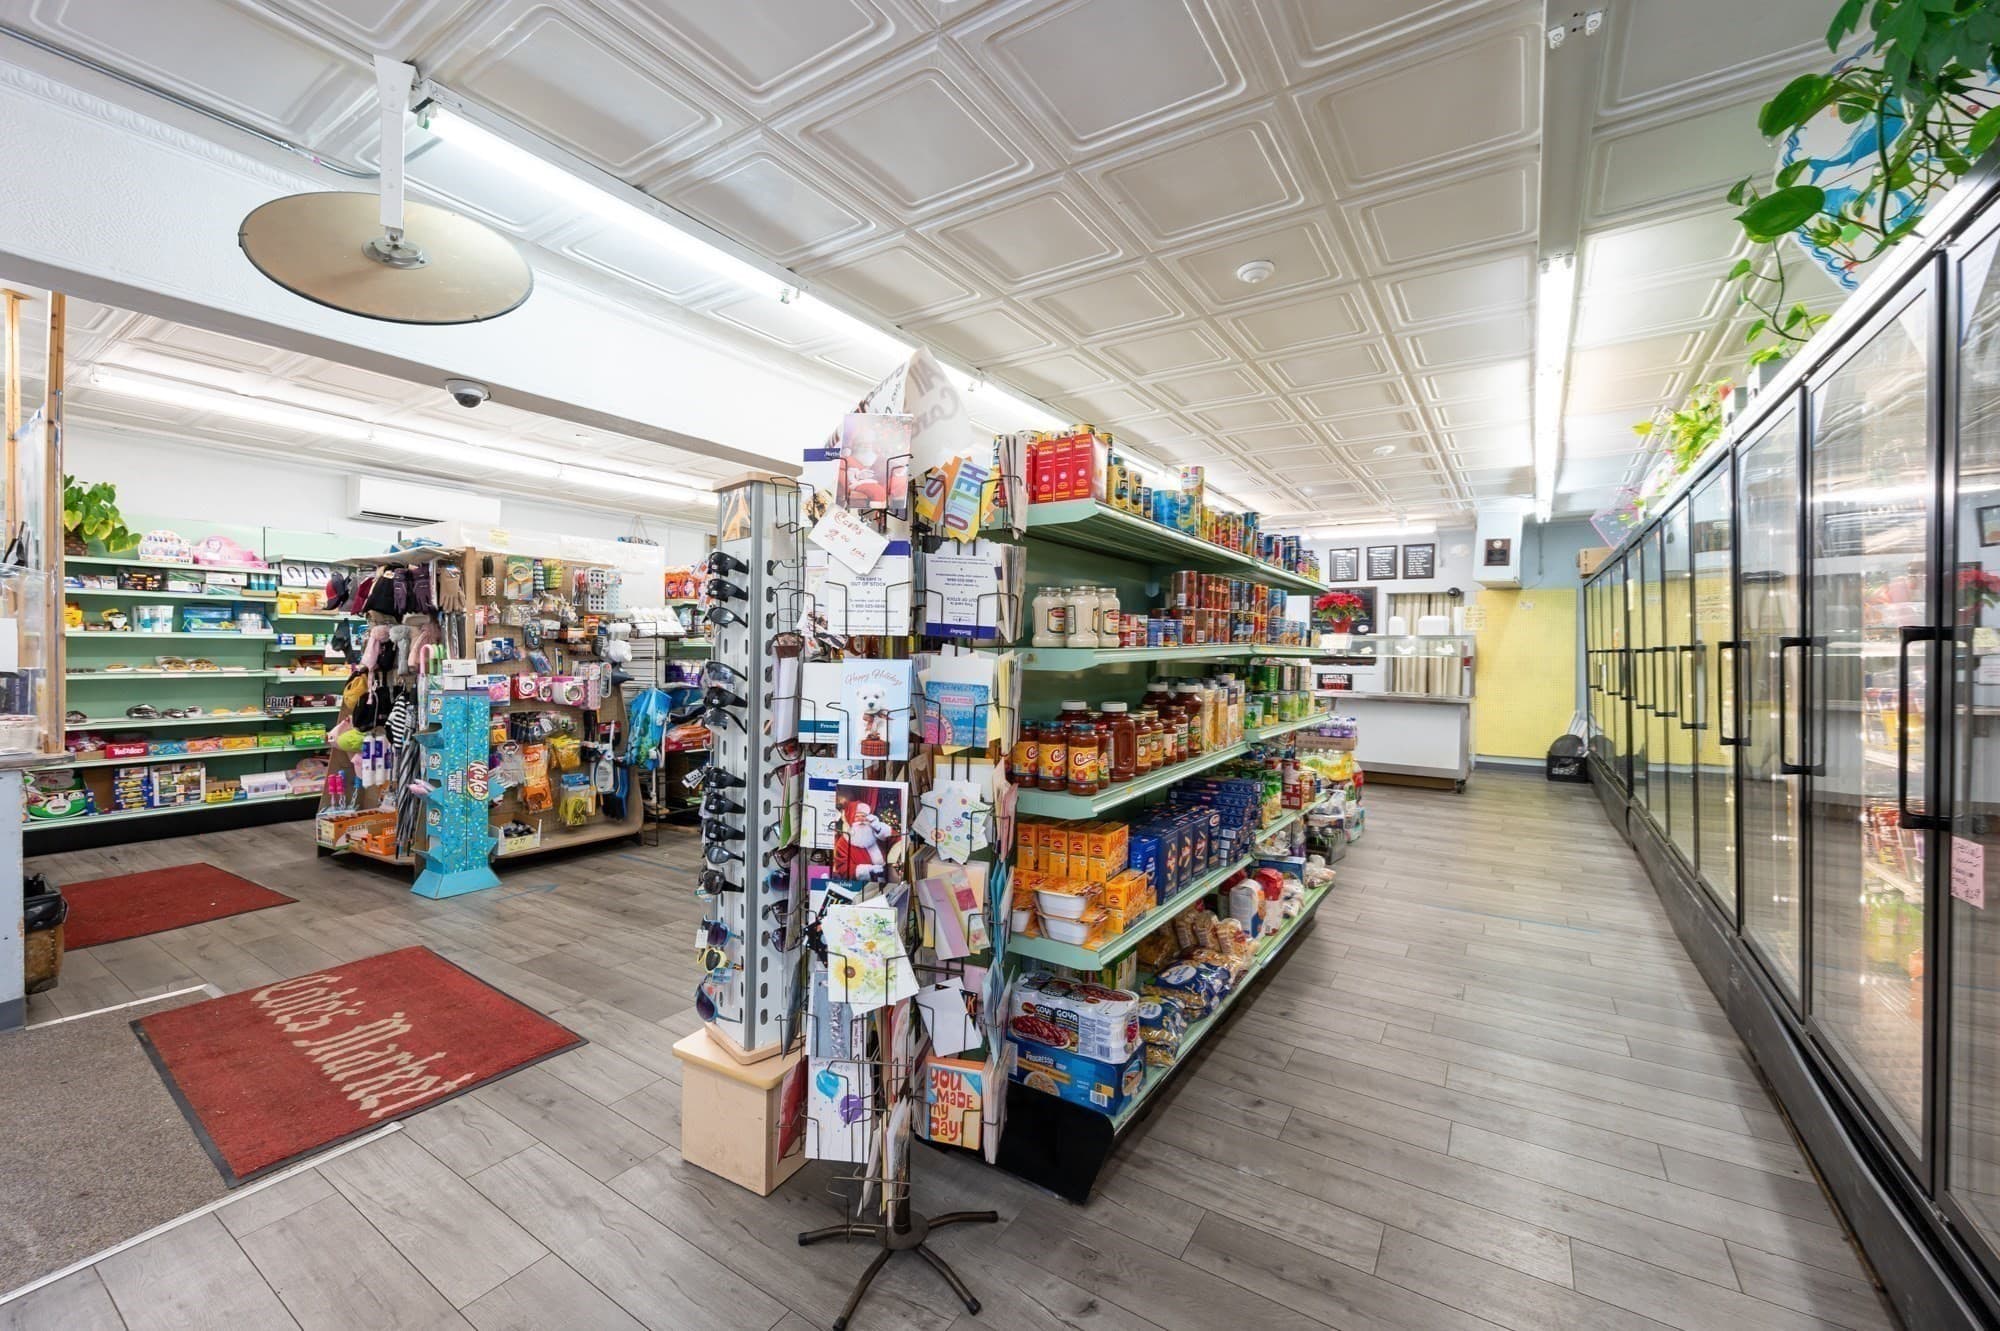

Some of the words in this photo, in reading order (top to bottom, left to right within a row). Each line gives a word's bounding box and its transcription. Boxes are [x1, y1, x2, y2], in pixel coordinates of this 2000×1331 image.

[250, 974, 366, 1032] Cote's
[1056, 1009, 1078, 1022] GOYA
[292, 1011, 477, 1118] Market
[930, 1103, 949, 1120] my
